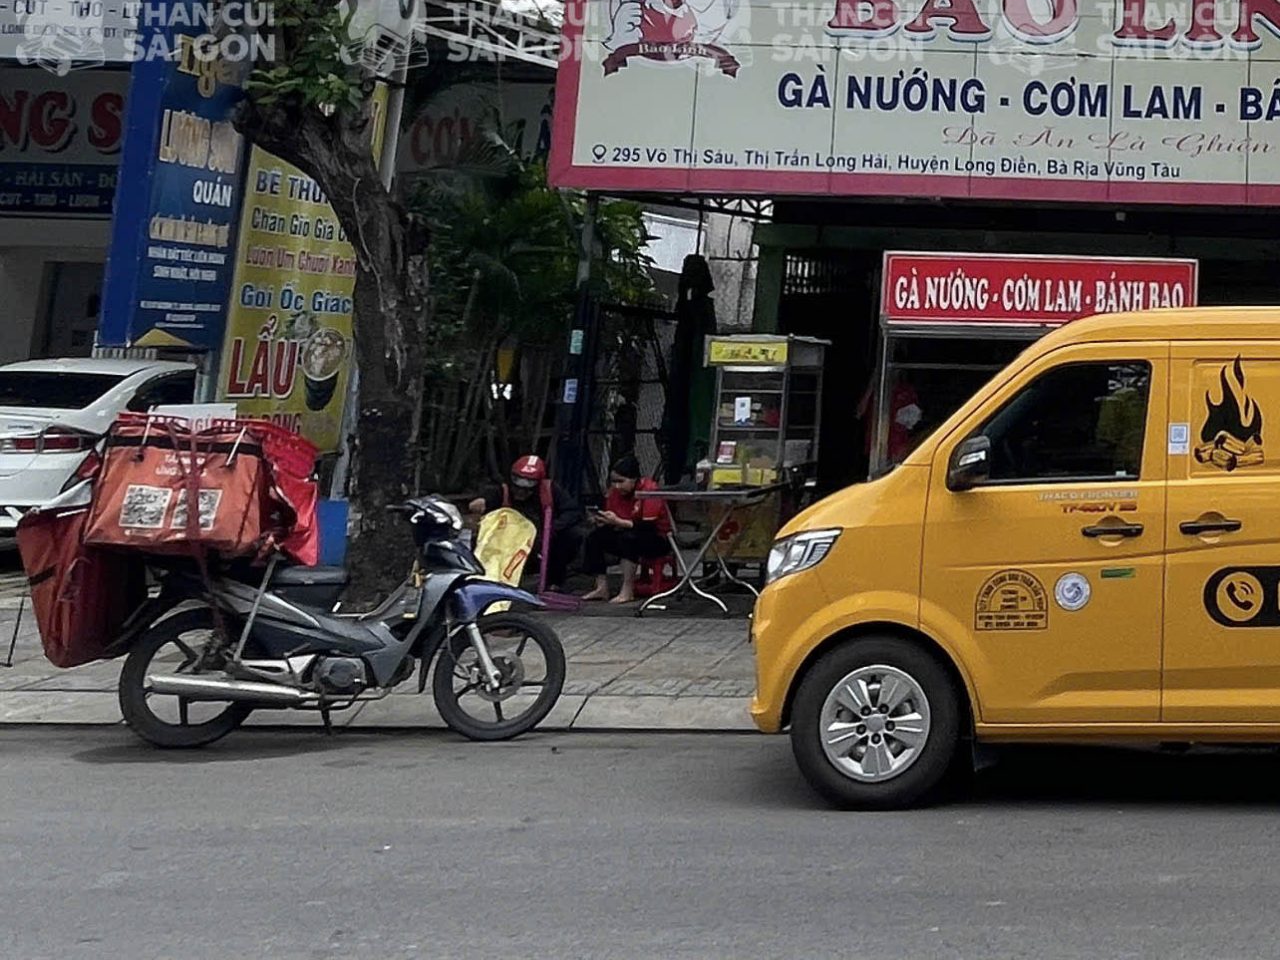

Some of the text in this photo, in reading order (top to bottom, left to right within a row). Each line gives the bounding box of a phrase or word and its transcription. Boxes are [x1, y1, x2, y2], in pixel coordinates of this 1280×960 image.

[778, 64, 831, 109] GÀ
[847, 71, 986, 114] NƯỚNG
[1023, 76, 1108, 118] CƠM
[1122, 85, 1202, 121] LAM
[612, 147, 641, 162] 295
[674, 149, 698, 167] Thị
[745, 150, 769, 169] Thị
[775, 147, 810, 167] Trấn
[816, 152, 857, 171] Long
[898, 155, 949, 174] Huyện
[954, 157, 995, 176] Long
[1000, 156, 1041, 176] Điền,
[1047, 159, 1068, 176] Bà
[1073, 160, 1099, 179] Rịa
[1105, 161, 1146, 181] Vũng
[1151, 161, 1181, 179] Tàu
[193, 177, 232, 207] QUÁN
[288, 175, 329, 203] THU
[895, 268, 920, 310] GÀ
[924, 268, 989, 311] NƯỚNG
[1002, 273, 1039, 312] CƠM
[1044, 280, 1081, 312] LAM
[1095, 271, 1145, 312] BÁNH
[1149, 282, 1184, 309] BAO
[226, 312, 299, 399] LẨU
